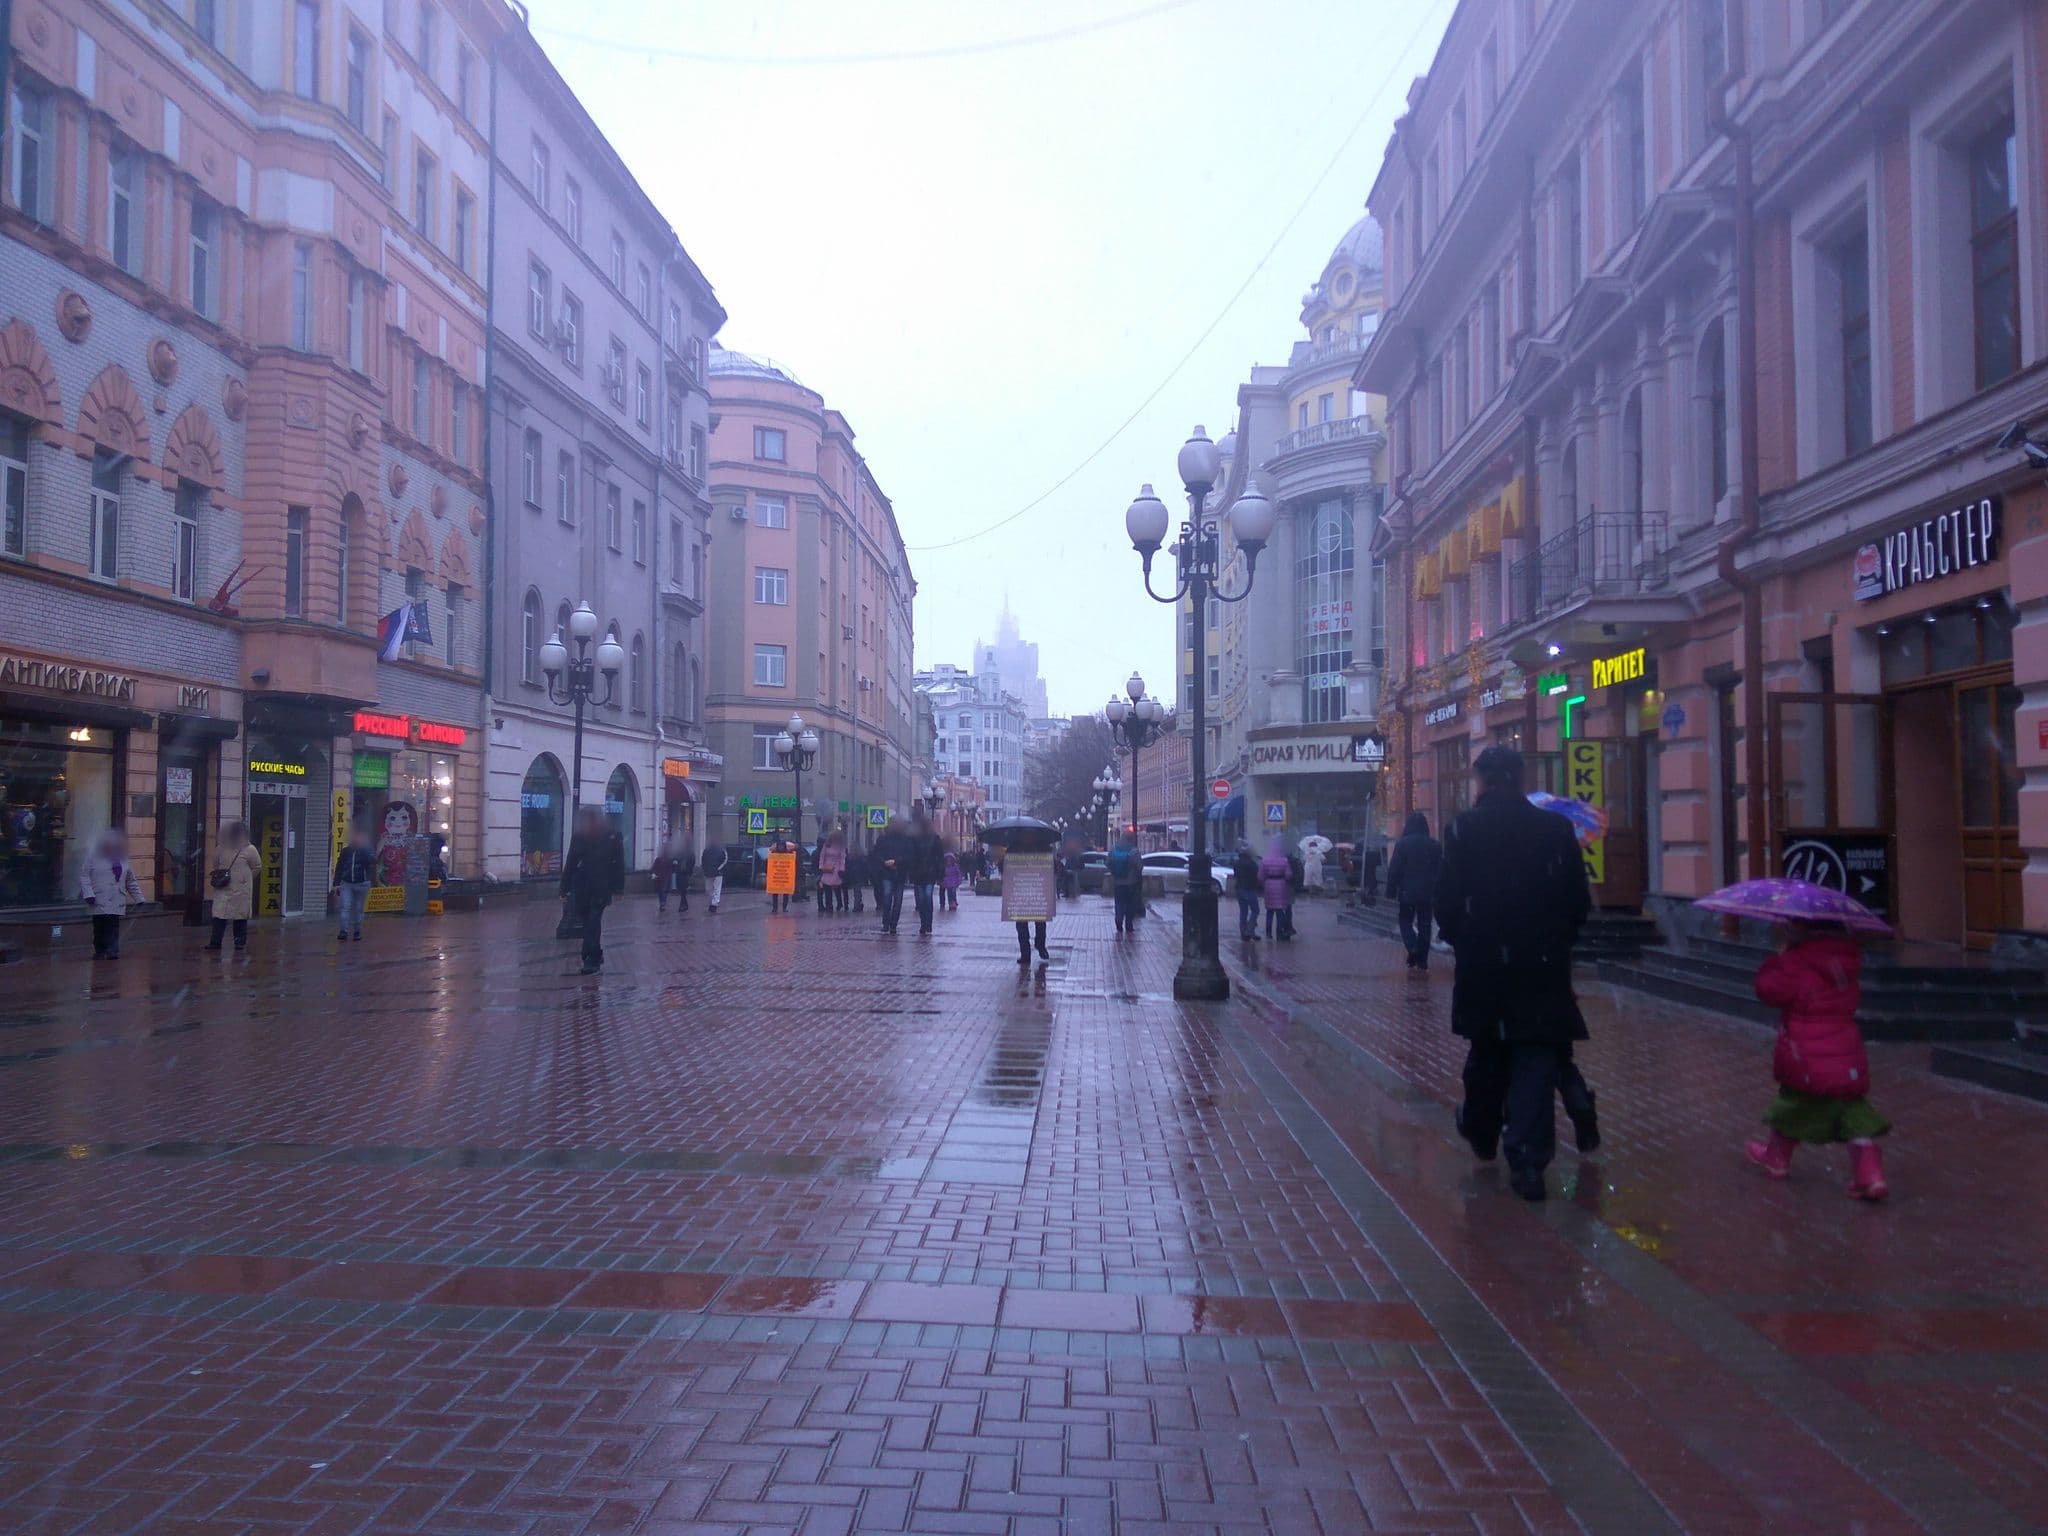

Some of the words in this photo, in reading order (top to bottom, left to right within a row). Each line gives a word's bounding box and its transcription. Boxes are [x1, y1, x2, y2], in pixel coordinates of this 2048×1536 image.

[1885, 499, 1993, 592] КРАБСТЕР
[0, 657, 139, 700] АНТИКВАРИАТ
[1592, 648, 1646, 689] РАРИТЕТ
[354, 711, 408, 738] РУССКИЙ
[250, 761, 284, 774] РУССКИЕ
[284, 764, 305, 776] ЧАСЫ
[1254, 744, 1294, 762] СТАРАЯ
[1296, 742, 1352, 761] УЛИЦА
[266, 820, 282, 910] СКУПКА
